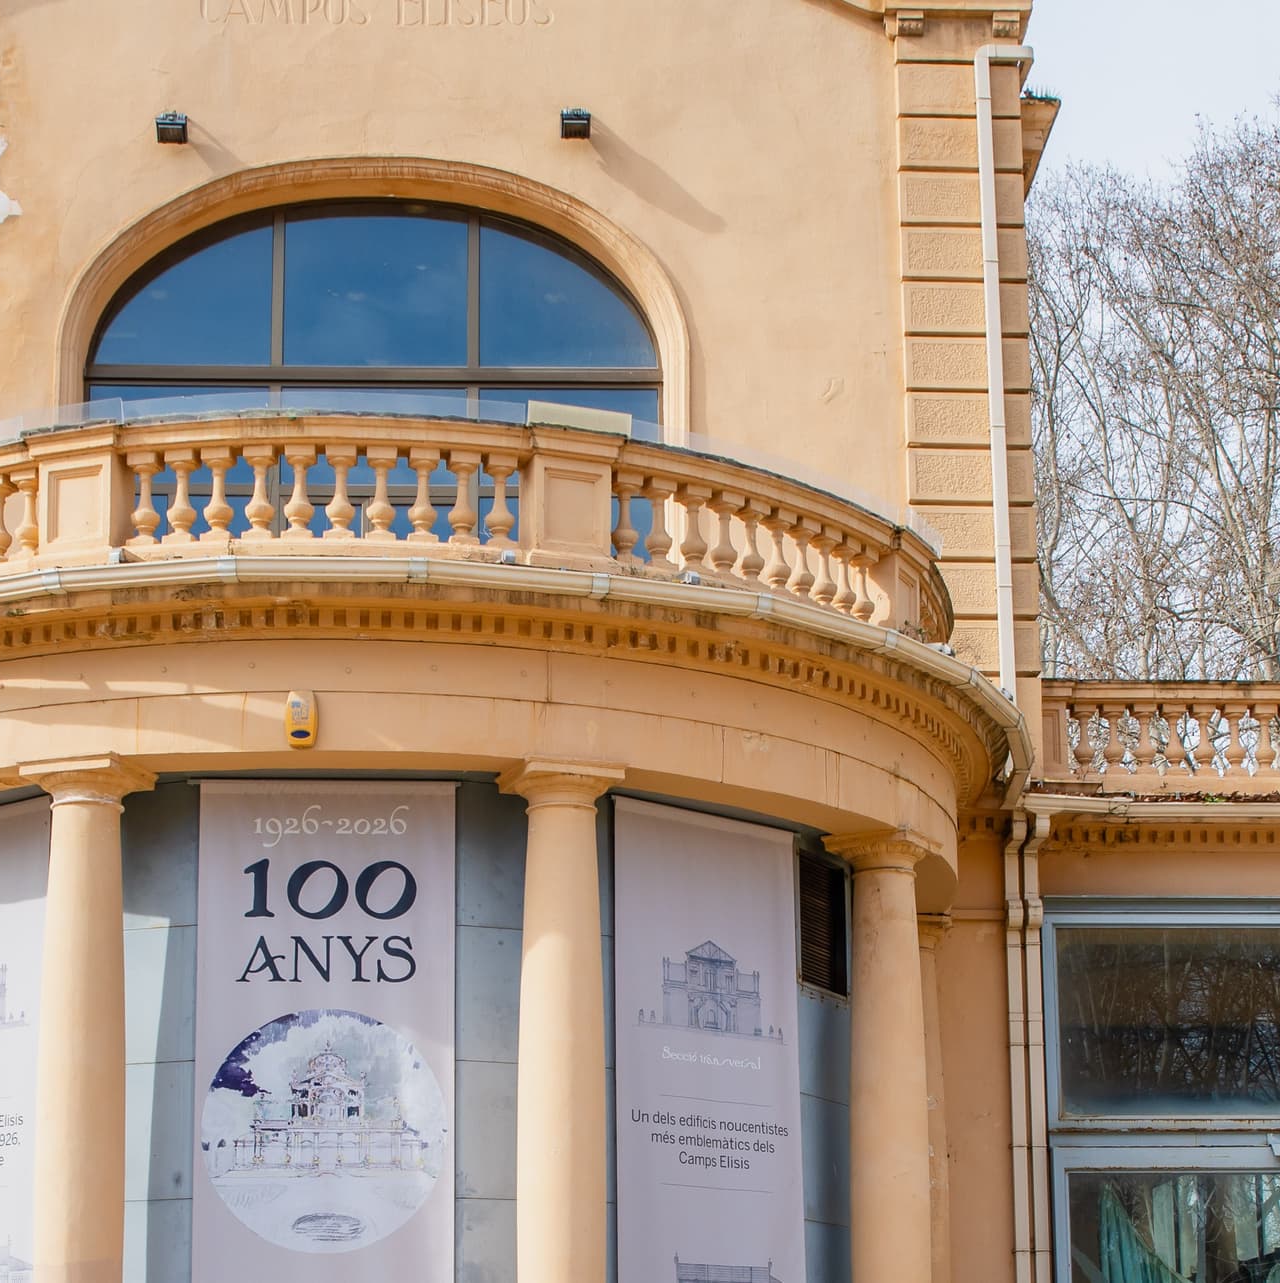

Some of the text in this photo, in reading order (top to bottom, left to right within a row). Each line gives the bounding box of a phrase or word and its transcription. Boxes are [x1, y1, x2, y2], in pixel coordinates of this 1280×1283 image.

[243, 858, 417, 920] 100
[235, 935, 417, 983] ANYS
[631, 1108, 789, 1137] Un dels edificis noucentistes
[651, 1131, 776, 1154] més emblemàtics dels
[678, 1150, 750, 1170] Camps Elisis
